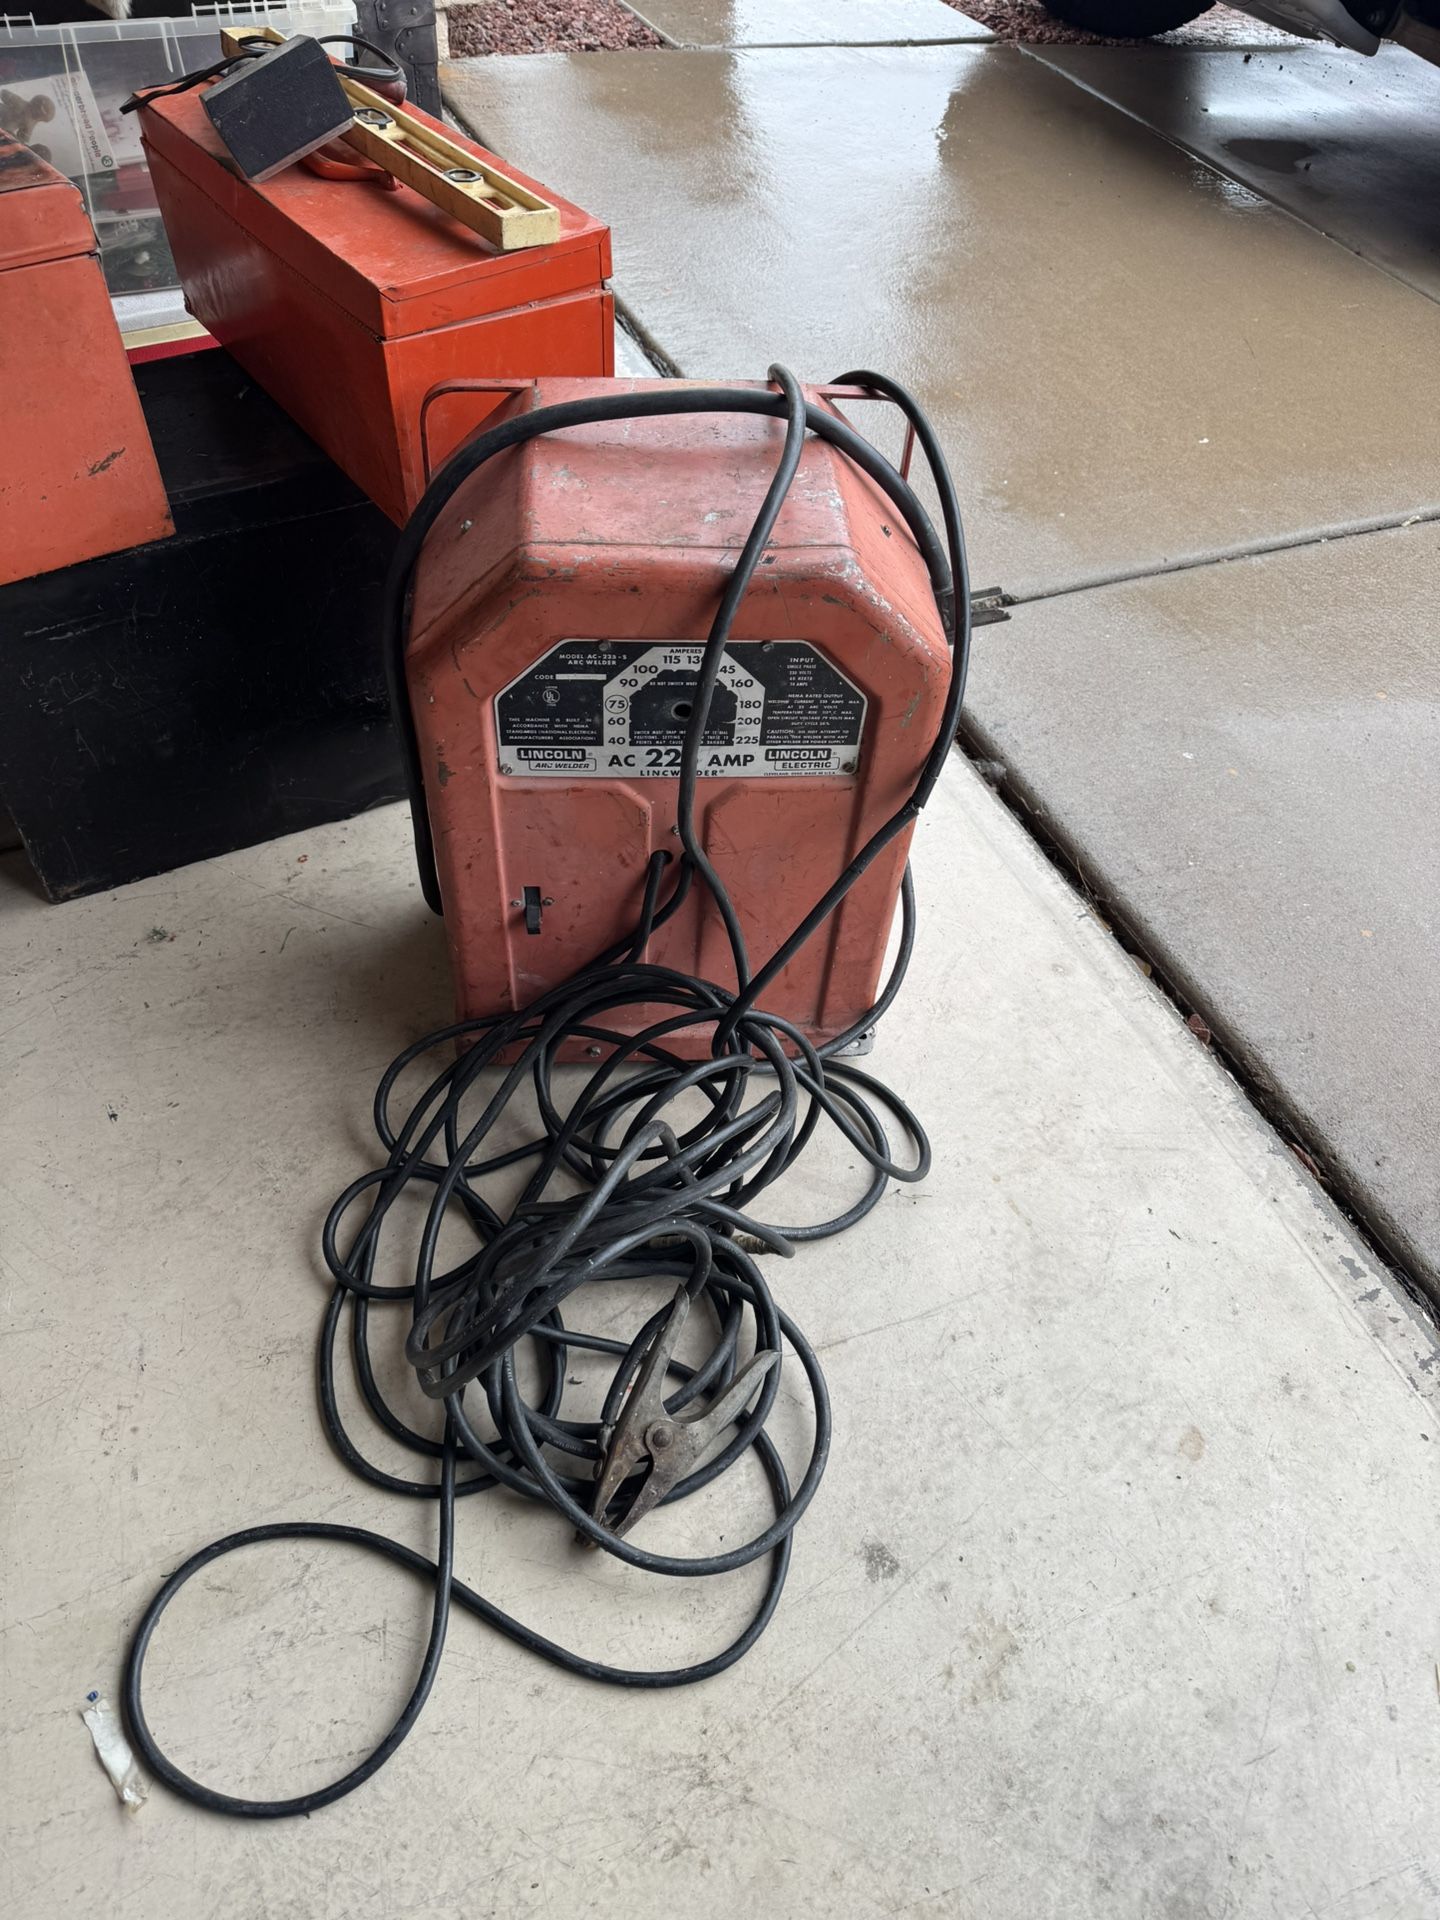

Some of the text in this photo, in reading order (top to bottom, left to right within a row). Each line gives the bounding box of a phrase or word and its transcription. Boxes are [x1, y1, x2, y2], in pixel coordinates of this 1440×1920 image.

[663, 655, 704, 664] 115 13
[632, 664, 658, 674] 100
[719, 665, 736, 674] 45
[619, 678, 638, 688] 90
[730, 678, 754, 688] 160
[609, 700, 625, 709] 75
[739, 700, 762, 709] 180
[607, 717, 626, 726] 60
[737, 717, 761, 726] 200
[608, 736, 626, 745] 40
[735, 735, 759, 745] 225
[520, 750, 583, 760] LINCOLN
[608, 749, 755, 767] AC 22 AMP
[768, 750, 828, 759] LINCOLN
[782, 761, 832, 769] ELECTRIC
